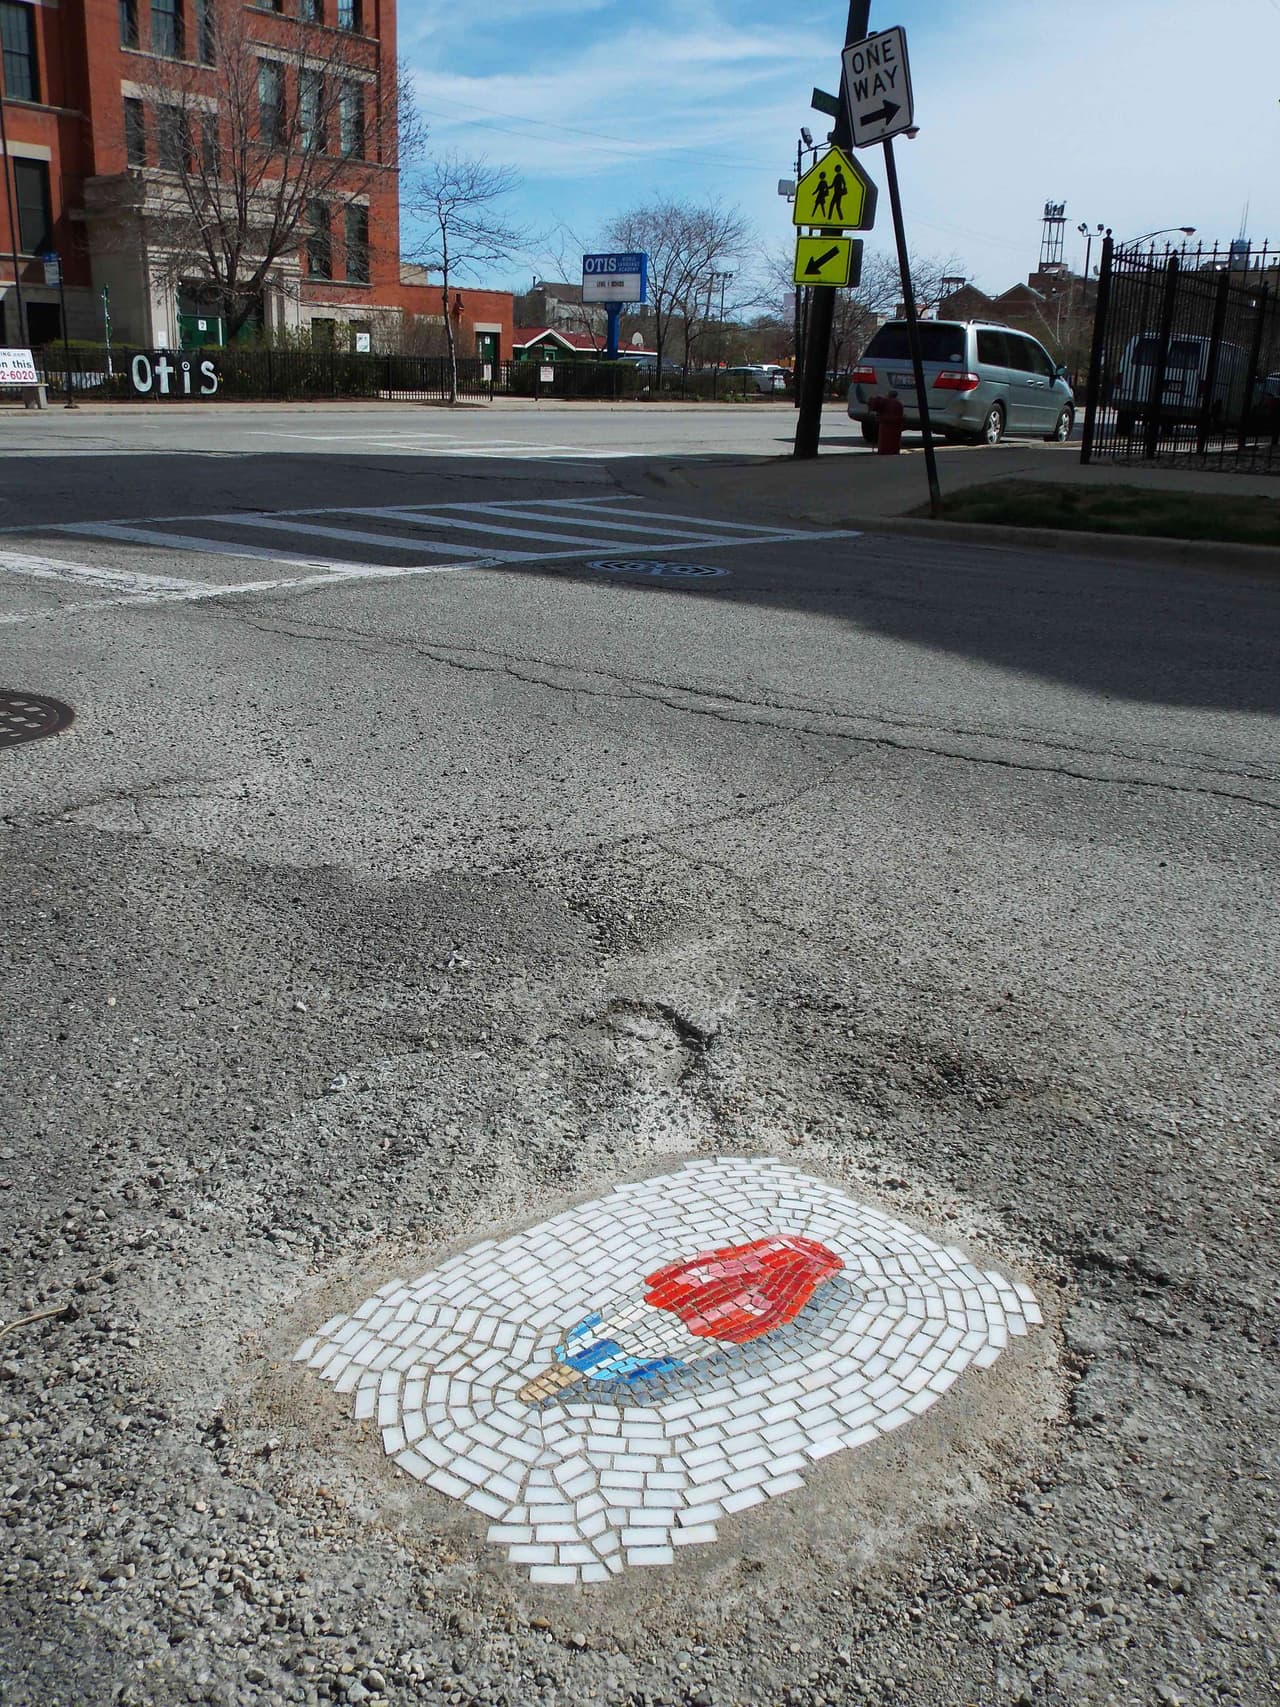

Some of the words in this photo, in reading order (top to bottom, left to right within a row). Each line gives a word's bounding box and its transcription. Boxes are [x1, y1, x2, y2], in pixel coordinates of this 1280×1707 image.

[852, 38, 895, 75] ONE
[853, 65, 898, 102] WAY
[585, 257, 617, 272] OTIS
[12, 360, 32, 368] this
